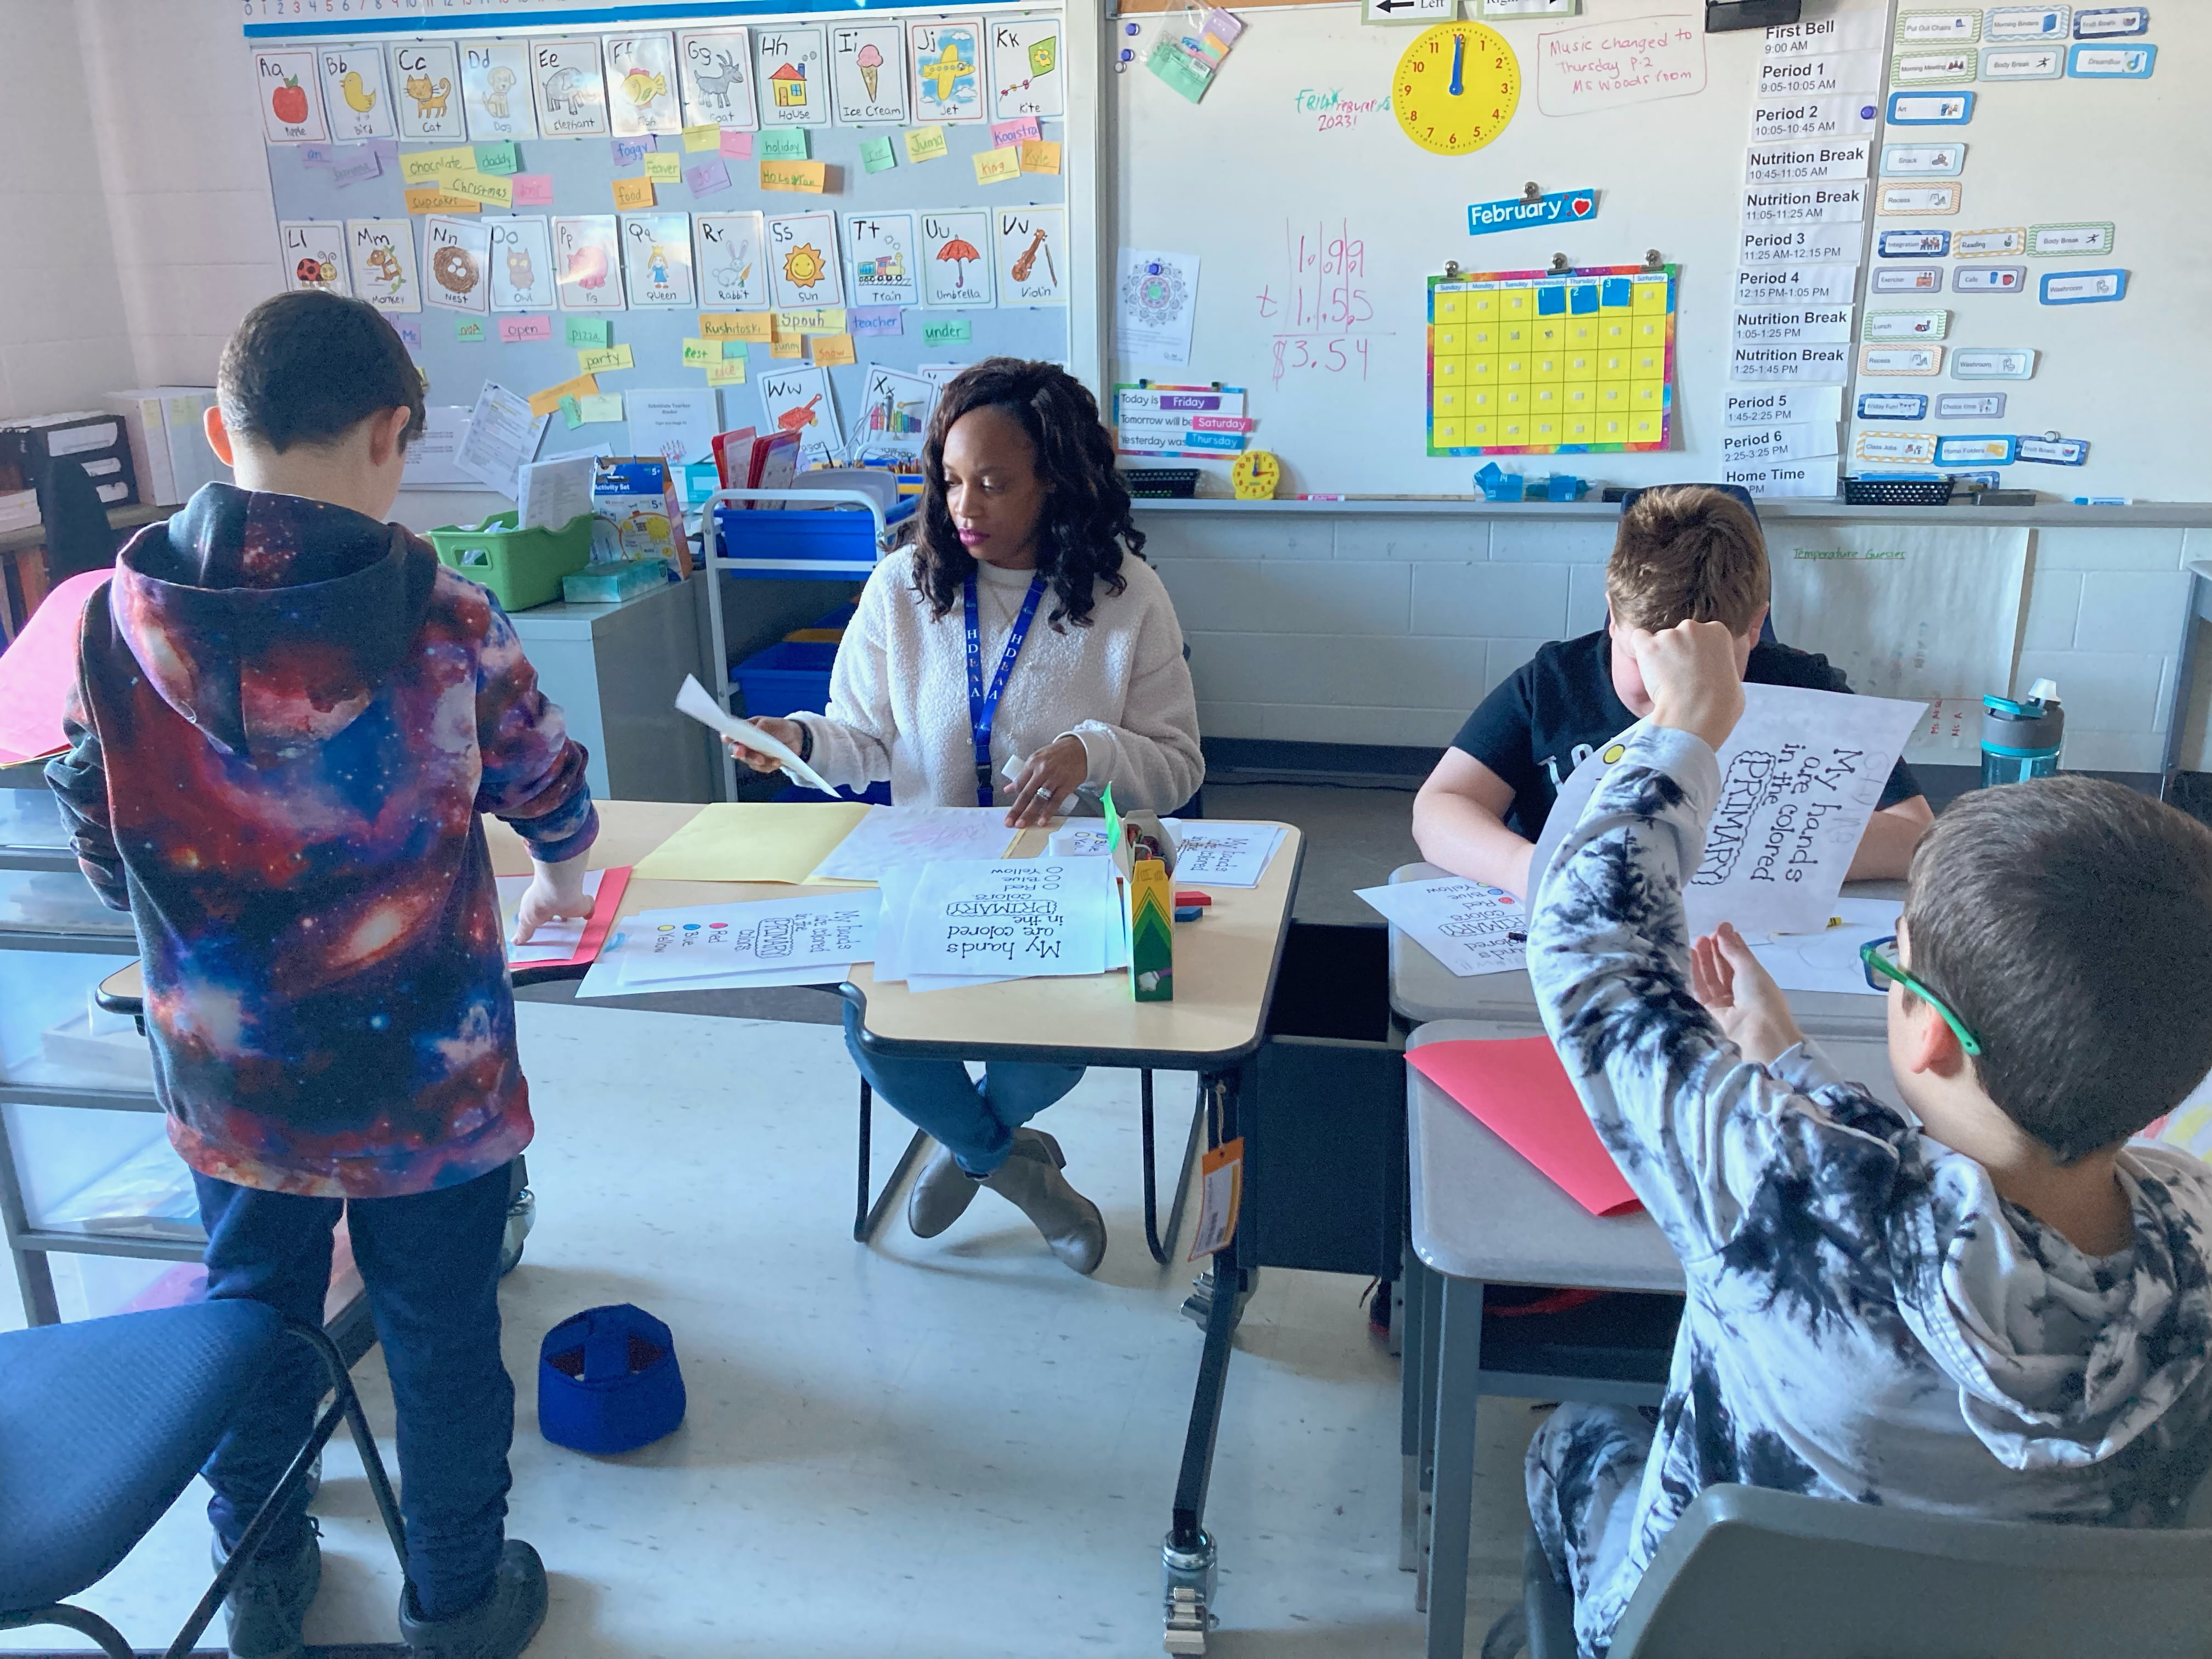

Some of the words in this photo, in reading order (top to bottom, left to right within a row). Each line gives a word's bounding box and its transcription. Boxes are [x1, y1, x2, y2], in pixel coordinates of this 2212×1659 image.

[1420, 0, 1444, 8] Left
[1766, 26, 1801, 40] First
[1806, 20, 1834, 35] Bell
[761, 35, 788, 56] Hh
[1550, 38, 1592, 57] Music
[1601, 33, 1667, 54] changed
[1675, 29, 1692, 41] to
[1765, 43, 1787, 54] 9:00
[1791, 41, 1808, 50] AM
[469, 48, 490, 69] Dd
[539, 51, 559, 67] Ee
[613, 41, 633, 64] Ff
[689, 41, 712, 64] Gg
[326, 57, 347, 75] Bb
[399, 50, 426, 70] Cc
[259, 59, 283, 77] Aa
[1558, 61, 1620, 78] Thursday
[1763, 64, 1811, 78] Period
[1818, 63, 1824, 75] 1
[1573, 79, 1593, 94] Ms
[1599, 74, 1649, 91] Woods
[1656, 71, 1691, 83] room
[1762, 80, 1815, 92] 9:05-10:05
[1818, 80, 1836, 89] AM
[710, 112, 735, 122] Goat
[843, 106, 863, 117] Ice
[866, 105, 901, 116] Cream
[940, 105, 959, 115] Jet
[1756, 106, 1804, 121] Period
[1809, 105, 1818, 117] 2
[285, 126, 306, 137] Apple
[354, 124, 373, 135] Bird
[422, 122, 441, 133] Cat
[494, 121, 512, 133] Dog
[1756, 123, 1815, 135] 10:05-10:45
[1818, 121, 1835, 131] AM
[617, 143, 648, 158] foggy
[765, 140, 800, 154] holiday
[483, 154, 511, 170] daddy
[1751, 151, 1814, 165] Nutrition
[1820, 148, 1864, 161] Break
[410, 157, 462, 177] chocolate
[1750, 168, 1807, 179] 10:45-11:05
[1811, 167, 1827, 176] AM
[453, 178, 506, 198] Christmas
[618, 188, 641, 202] food
[1748, 193, 1810, 206] Nutrition
[1816, 190, 1860, 203] Break
[1471, 199, 1562, 225] February
[1747, 210, 1803, 219] 11:05-11:25
[1805, 208, 1822, 217] AM
[854, 221, 879, 240] Tt
[926, 219, 950, 239] Uu
[1003, 215, 1029, 235] Vv
[358, 229, 390, 246] Mm
[433, 227, 458, 246] Nn
[703, 223, 724, 242] Rr
[774, 226, 793, 241] Ss
[1746, 233, 1792, 246] Period
[1797, 233, 1804, 244] 3
[1740, 273, 1786, 284] Period
[1791, 272, 1799, 283] 4
[445, 294, 468, 304] Nest
[515, 294, 533, 303] Owl
[719, 290, 749, 301] Rabbit
[873, 291, 901, 302] Train
[936, 289, 981, 300] Umbrella
[1022, 286, 1051, 298] Violin
[373, 295, 404, 305] Monkey
[853, 315, 896, 329] teacher
[1738, 313, 1799, 325] Nutrition
[1805, 312, 1847, 323] Break
[508, 324, 539, 336] open
[926, 326, 963, 338] under
[1737, 329, 1781, 338] 1:05-1:25
[1784, 329, 1801, 337] PM
[586, 352, 619, 370] party
[1736, 349, 1797, 361] Nutrition
[1803, 349, 1844, 361] Break
[1735, 365, 1779, 374] 1:25-1:45
[1782, 365, 1798, 374] PM
[1121, 394, 1149, 405] Today
[1151, 394, 1158, 404] is
[1173, 397, 1205, 409] Friday
[1729, 396, 1773, 409] Period
[1779, 396, 1786, 406] 5
[1121, 415, 1163, 424] Tomorrow
[1165, 417, 1180, 426] will
[1182, 417, 1193, 426] be
[1199, 418, 1245, 429] Saturday
[1729, 411, 1771, 421] 1:45-2:25
[1776, 410, 1791, 419] PM
[1121, 435, 1165, 448] Yesterday
[1192, 434, 1238, 448] Thursday
[1725, 432, 1769, 449] Period
[1774, 431, 1782, 441] 6
[1725, 448, 1769, 462] 2:25-3:25
[1773, 445, 1788, 454] PM
[1727, 471, 1766, 482] Home
[1771, 469, 1805, 481] Time
[1793, 548, 1858, 561] Temperature
[1778, 743, 1807, 763] in
[1791, 756, 1820, 794] are
[1815, 748, 1863, 791] My
[1762, 771, 1793, 805] the
[1697, 758, 1771, 881] PRIMARY
[1750, 804, 1798, 881] colored
[1785, 803, 1842, 883] hands
[991, 867, 1041, 877] Yellow
[1004, 883, 1036, 891] Red
[1426, 884, 1476, 894] Yellow
[1447, 892, 1486, 900] Blue
[950, 902, 1053, 916] PRIMARY
[1463, 900, 1497, 910] Red
[829, 910, 860, 923] My
[1014, 916, 1042, 925] the
[1047, 916, 1064, 924] in
[708, 929, 727, 944] Red
[760, 918, 789, 957] PRIMARY
[837, 924, 863, 950] hands
[948, 926, 1014, 937] colored
[1023, 927, 1054, 937] are
[654, 932, 674, 953] Yellow
[682, 931, 699, 947] Blue
[946, 940, 1014, 960] hands
[1025, 938, 1062, 959] My
